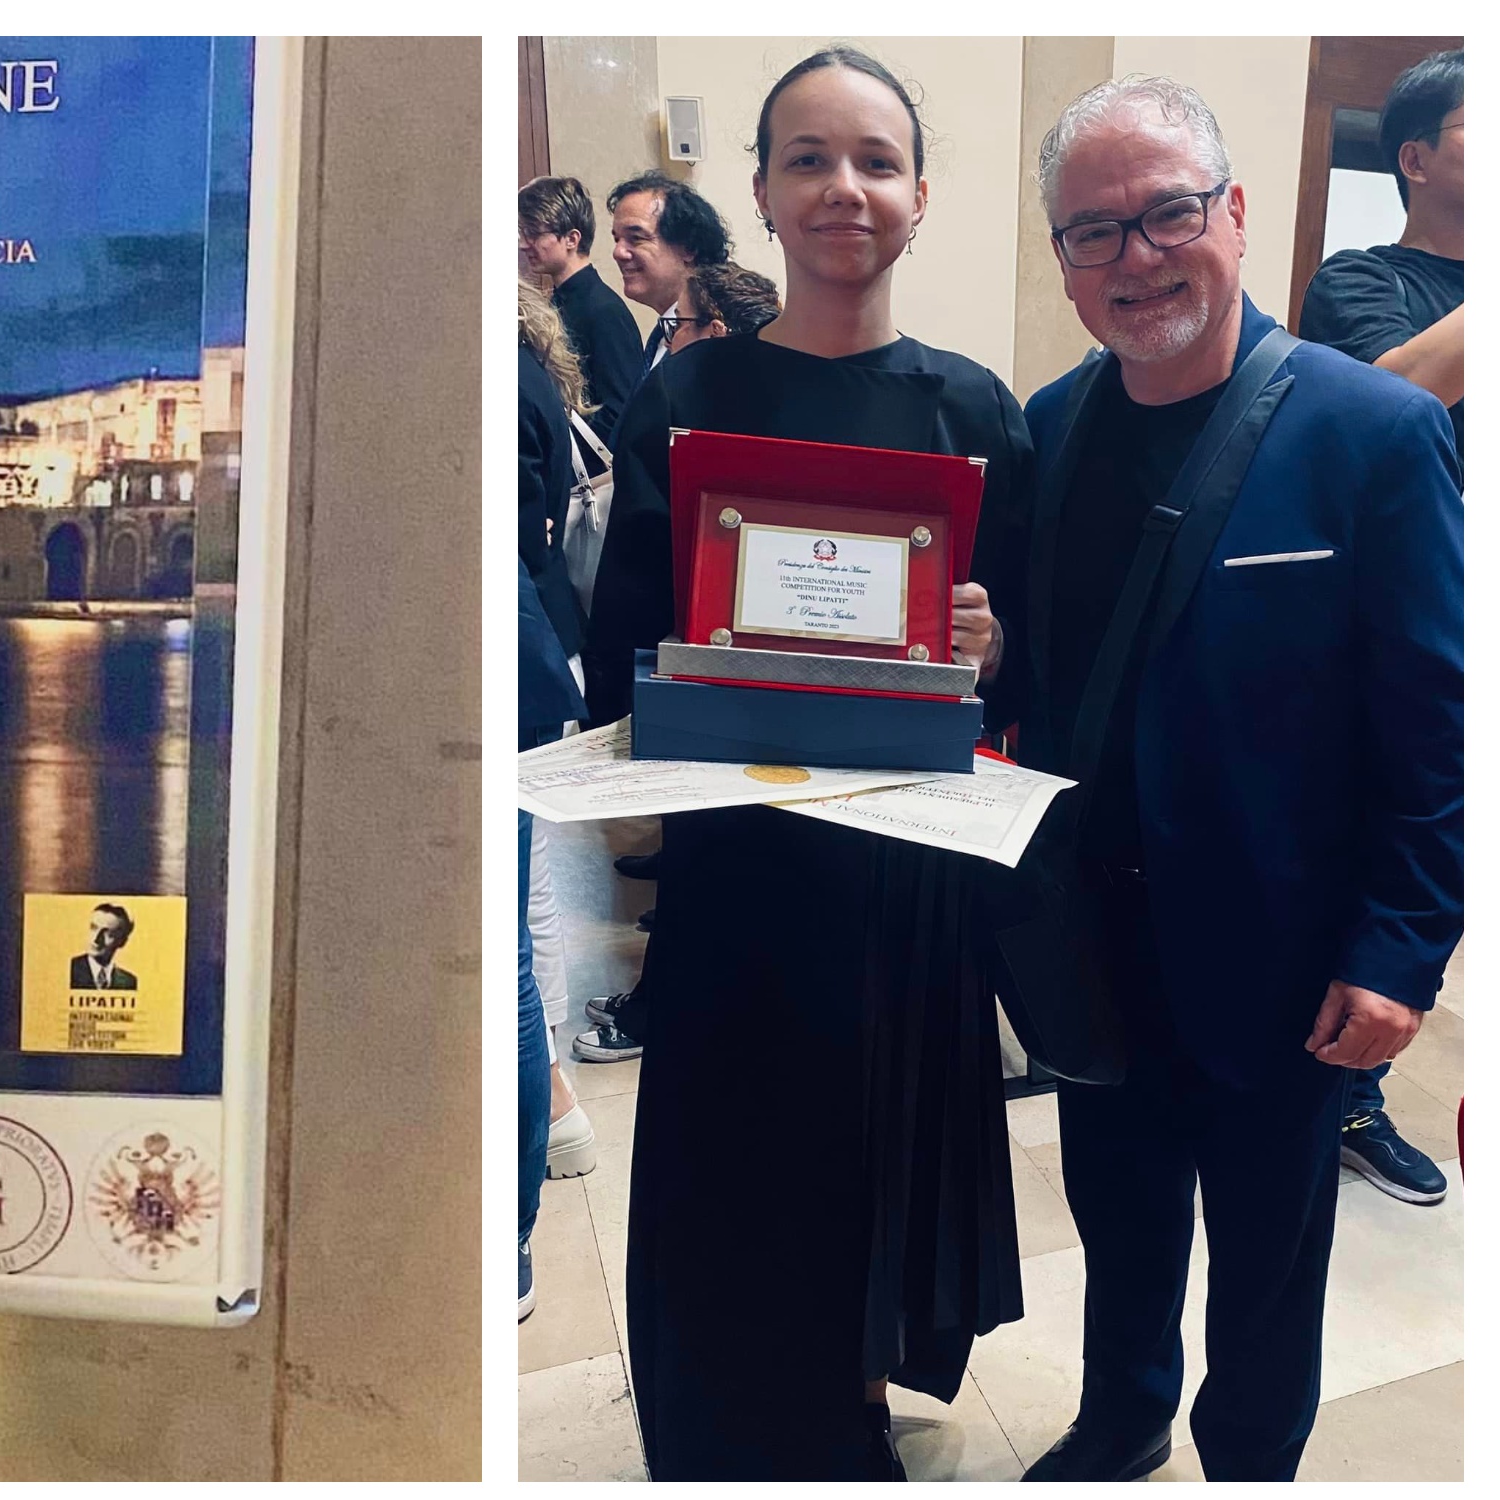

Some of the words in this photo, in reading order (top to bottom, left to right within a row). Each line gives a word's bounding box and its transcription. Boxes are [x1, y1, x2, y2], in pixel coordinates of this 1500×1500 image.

[780, 582, 826, 592] COMPETITION
[841, 588, 866, 596] YOUTH
[792, 575, 845, 587] INTERNATIONAL
[846, 581, 868, 589] MUSIC
[834, 803, 957, 837] INTERNATIONAL
[69, 995, 136, 1009] LIPATTI
